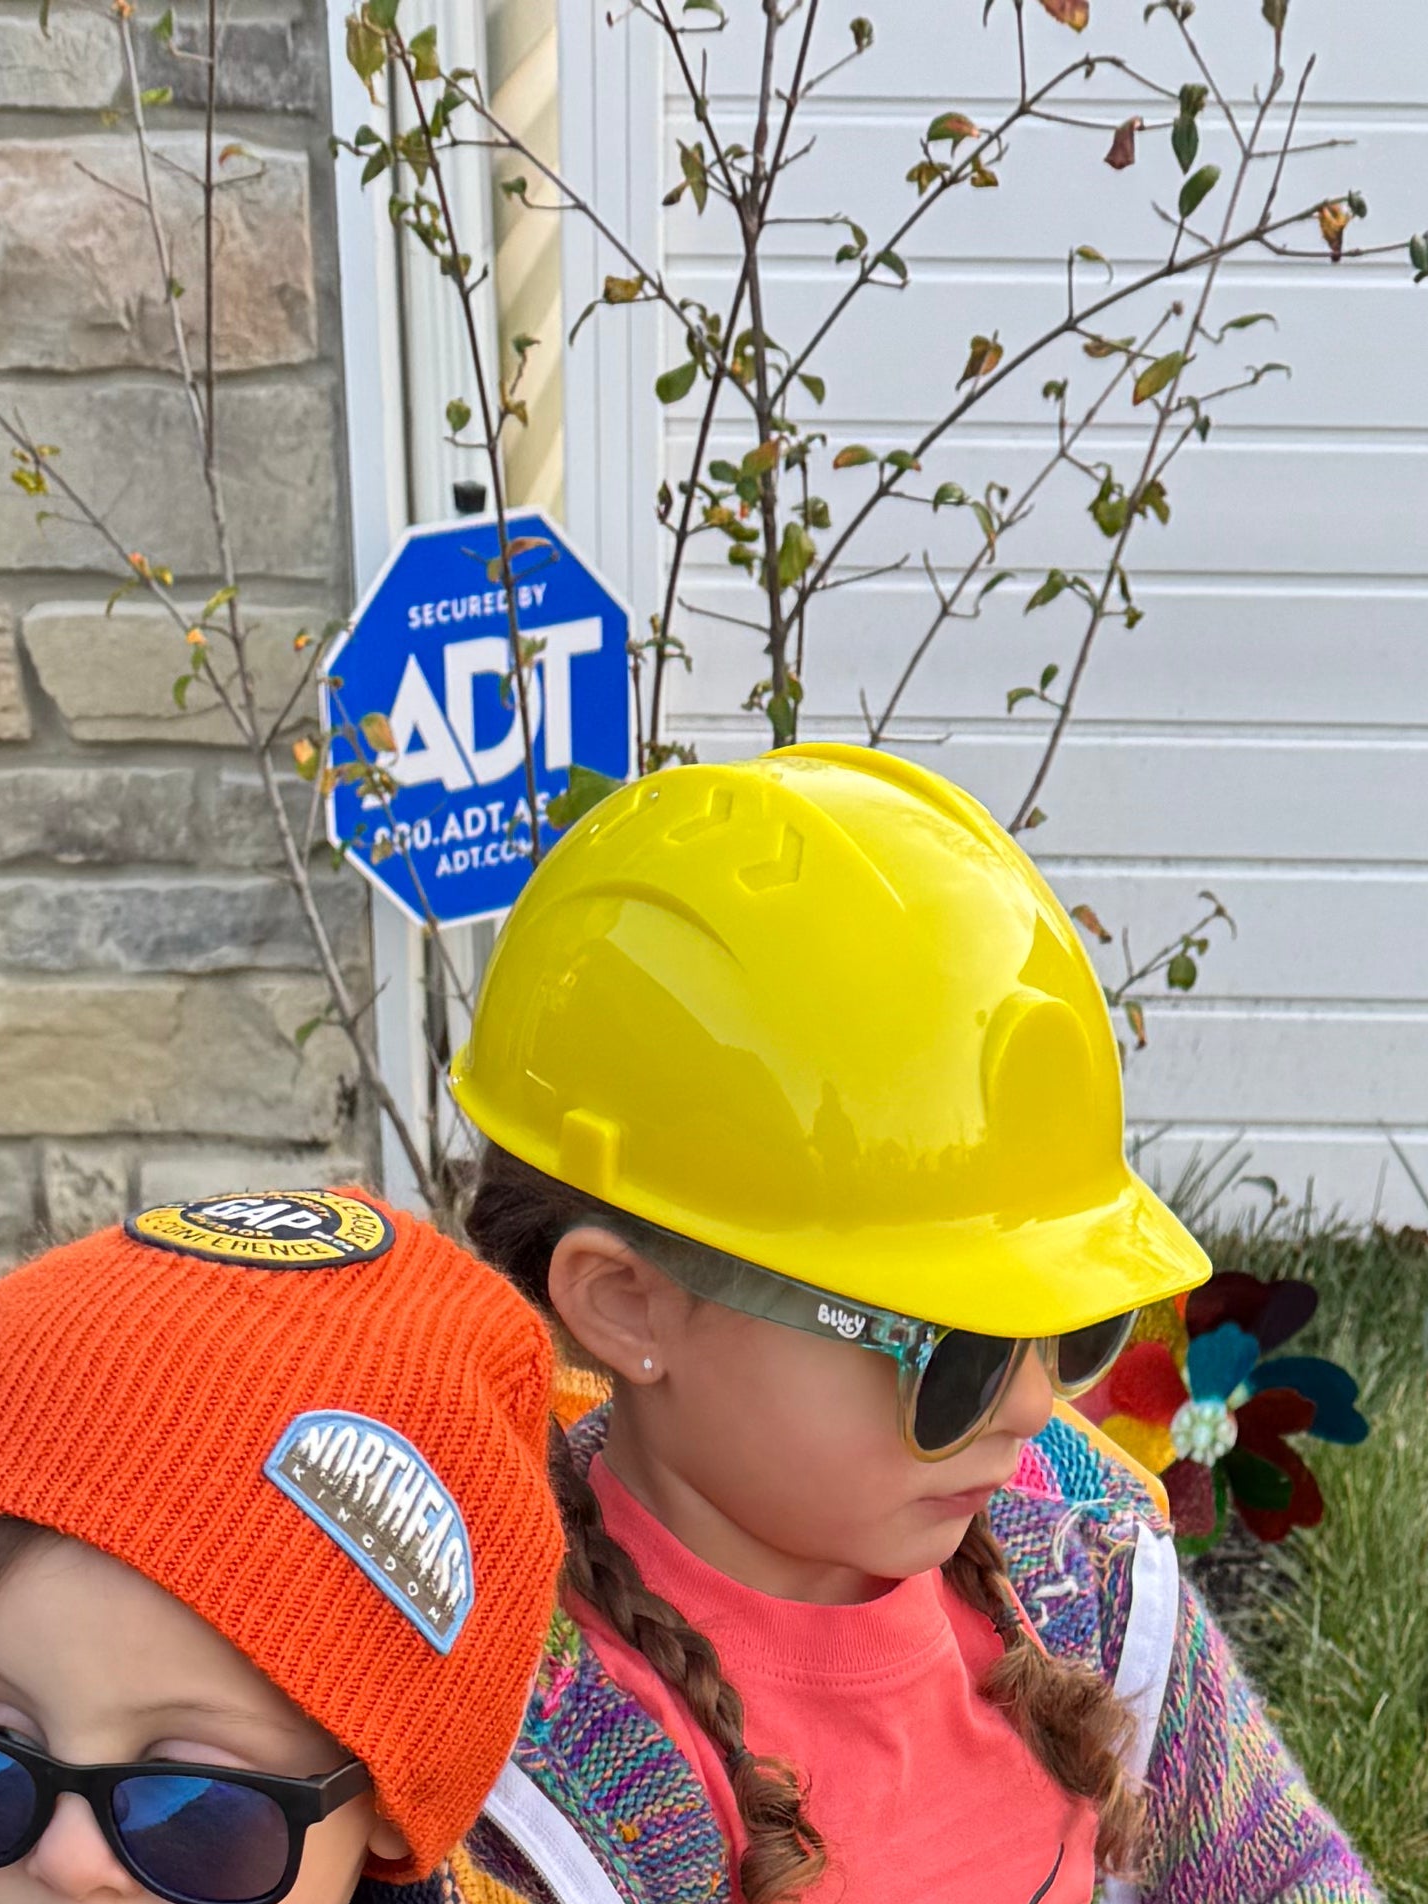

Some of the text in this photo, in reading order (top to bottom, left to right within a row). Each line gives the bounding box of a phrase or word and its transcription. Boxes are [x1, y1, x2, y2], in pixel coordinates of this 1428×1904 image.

[407, 582, 547, 630] SECURED BY
[360, 617, 603, 811] ADT
[201, 1198, 323, 1233] GAP
[291, 1464, 443, 1625] KINGDOM
[294, 1425, 468, 1612] NORTHEAST
